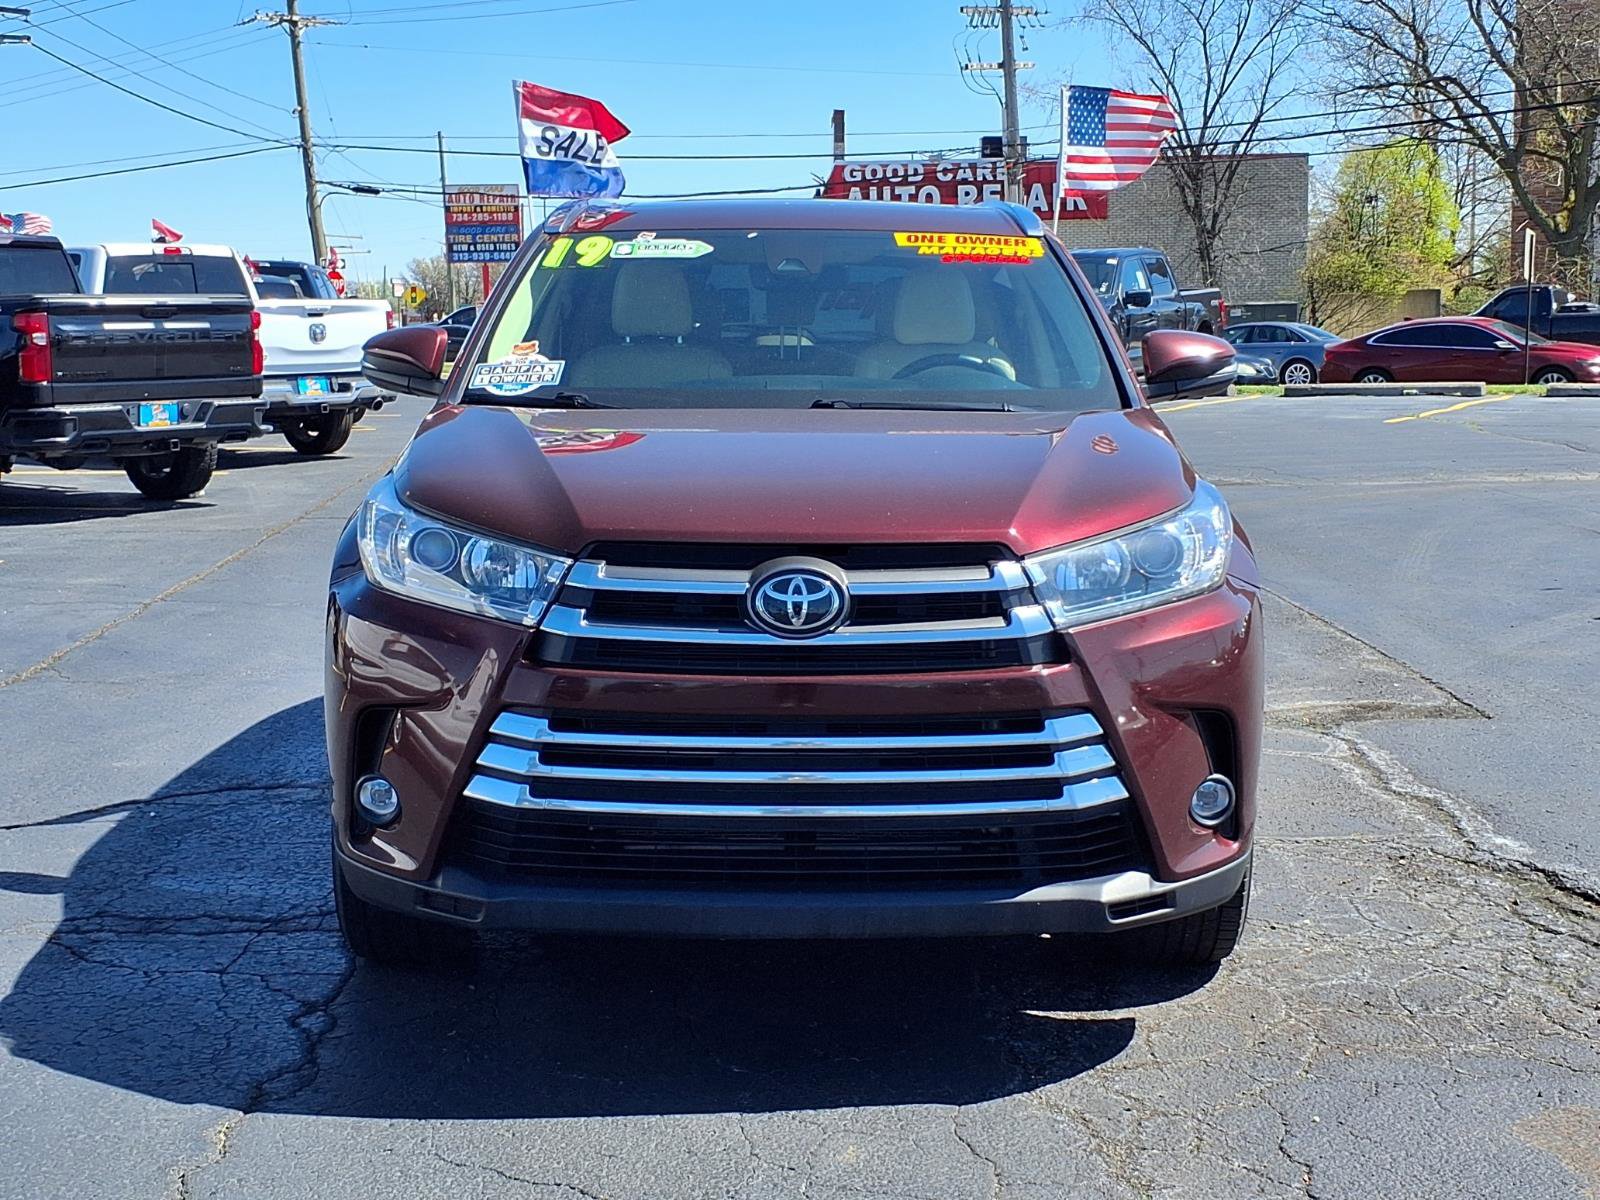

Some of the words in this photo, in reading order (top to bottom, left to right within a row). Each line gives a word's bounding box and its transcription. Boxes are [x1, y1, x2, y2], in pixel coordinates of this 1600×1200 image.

[536, 126, 605, 164] SALE
[843, 163, 924, 182] GOOD
[936, 161, 1006, 182] CARE
[448, 194, 475, 204] AUTO
[481, 194, 517, 204] REPAIR
[848, 185, 941, 204] AUTO
[957, 183, 1088, 212] REAIR
[460, 226, 482, 234] GOOD
[448, 234, 473, 243] TIRE
[476, 233, 519, 242] CENTER
[906, 234, 947, 244] ONE
[955, 236, 1027, 247] OWNER
[496, 243, 516, 251] TIRES
[541, 235, 614, 268] 19
[66, 331, 244, 345] CHEVROLET
[479, 365, 555, 375] CARFAX
